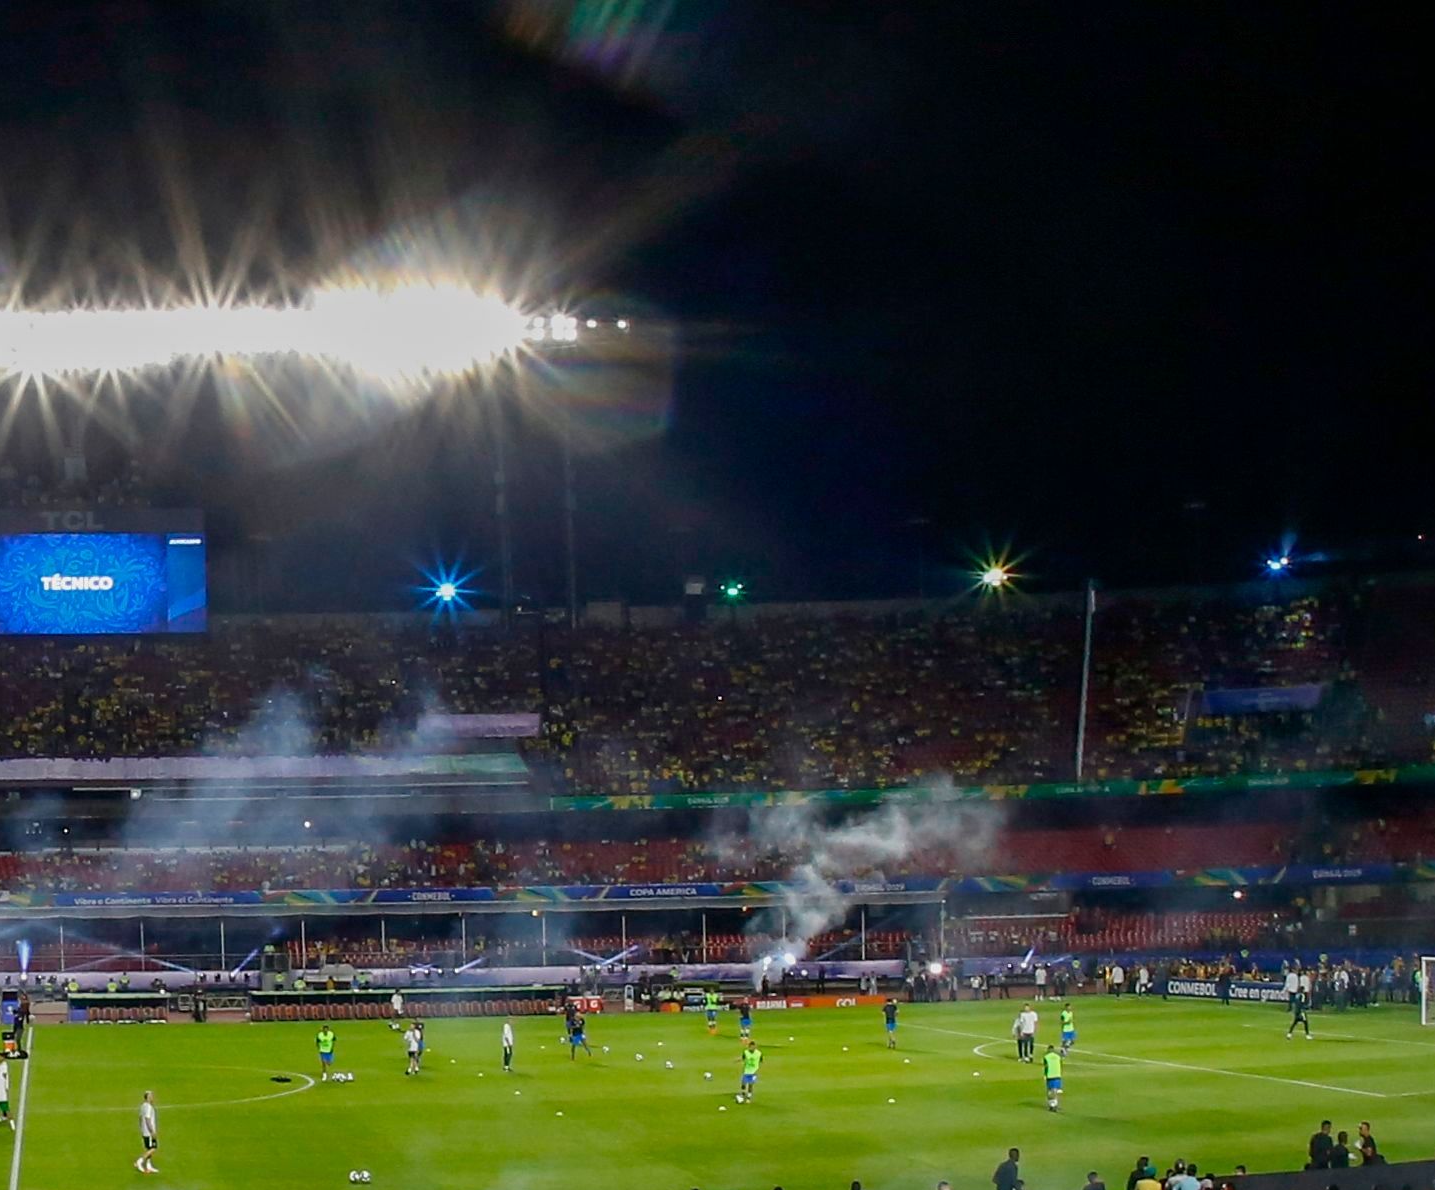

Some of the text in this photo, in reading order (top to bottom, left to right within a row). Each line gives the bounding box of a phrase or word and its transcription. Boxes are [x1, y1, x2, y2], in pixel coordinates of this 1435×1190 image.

[39, 510, 105, 530] TCL
[40, 573, 114, 591] TÉCNICO
[412, 892, 452, 901] CONMEBOL
[629, 887, 697, 897] COPA AMERICA
[74, 897, 97, 905] Vibra
[105, 897, 151, 905] Continente
[1168, 981, 1218, 996] CONMEBOL
[1249, 988, 1260, 998] en
[590, 1000, 598, 1009] G
